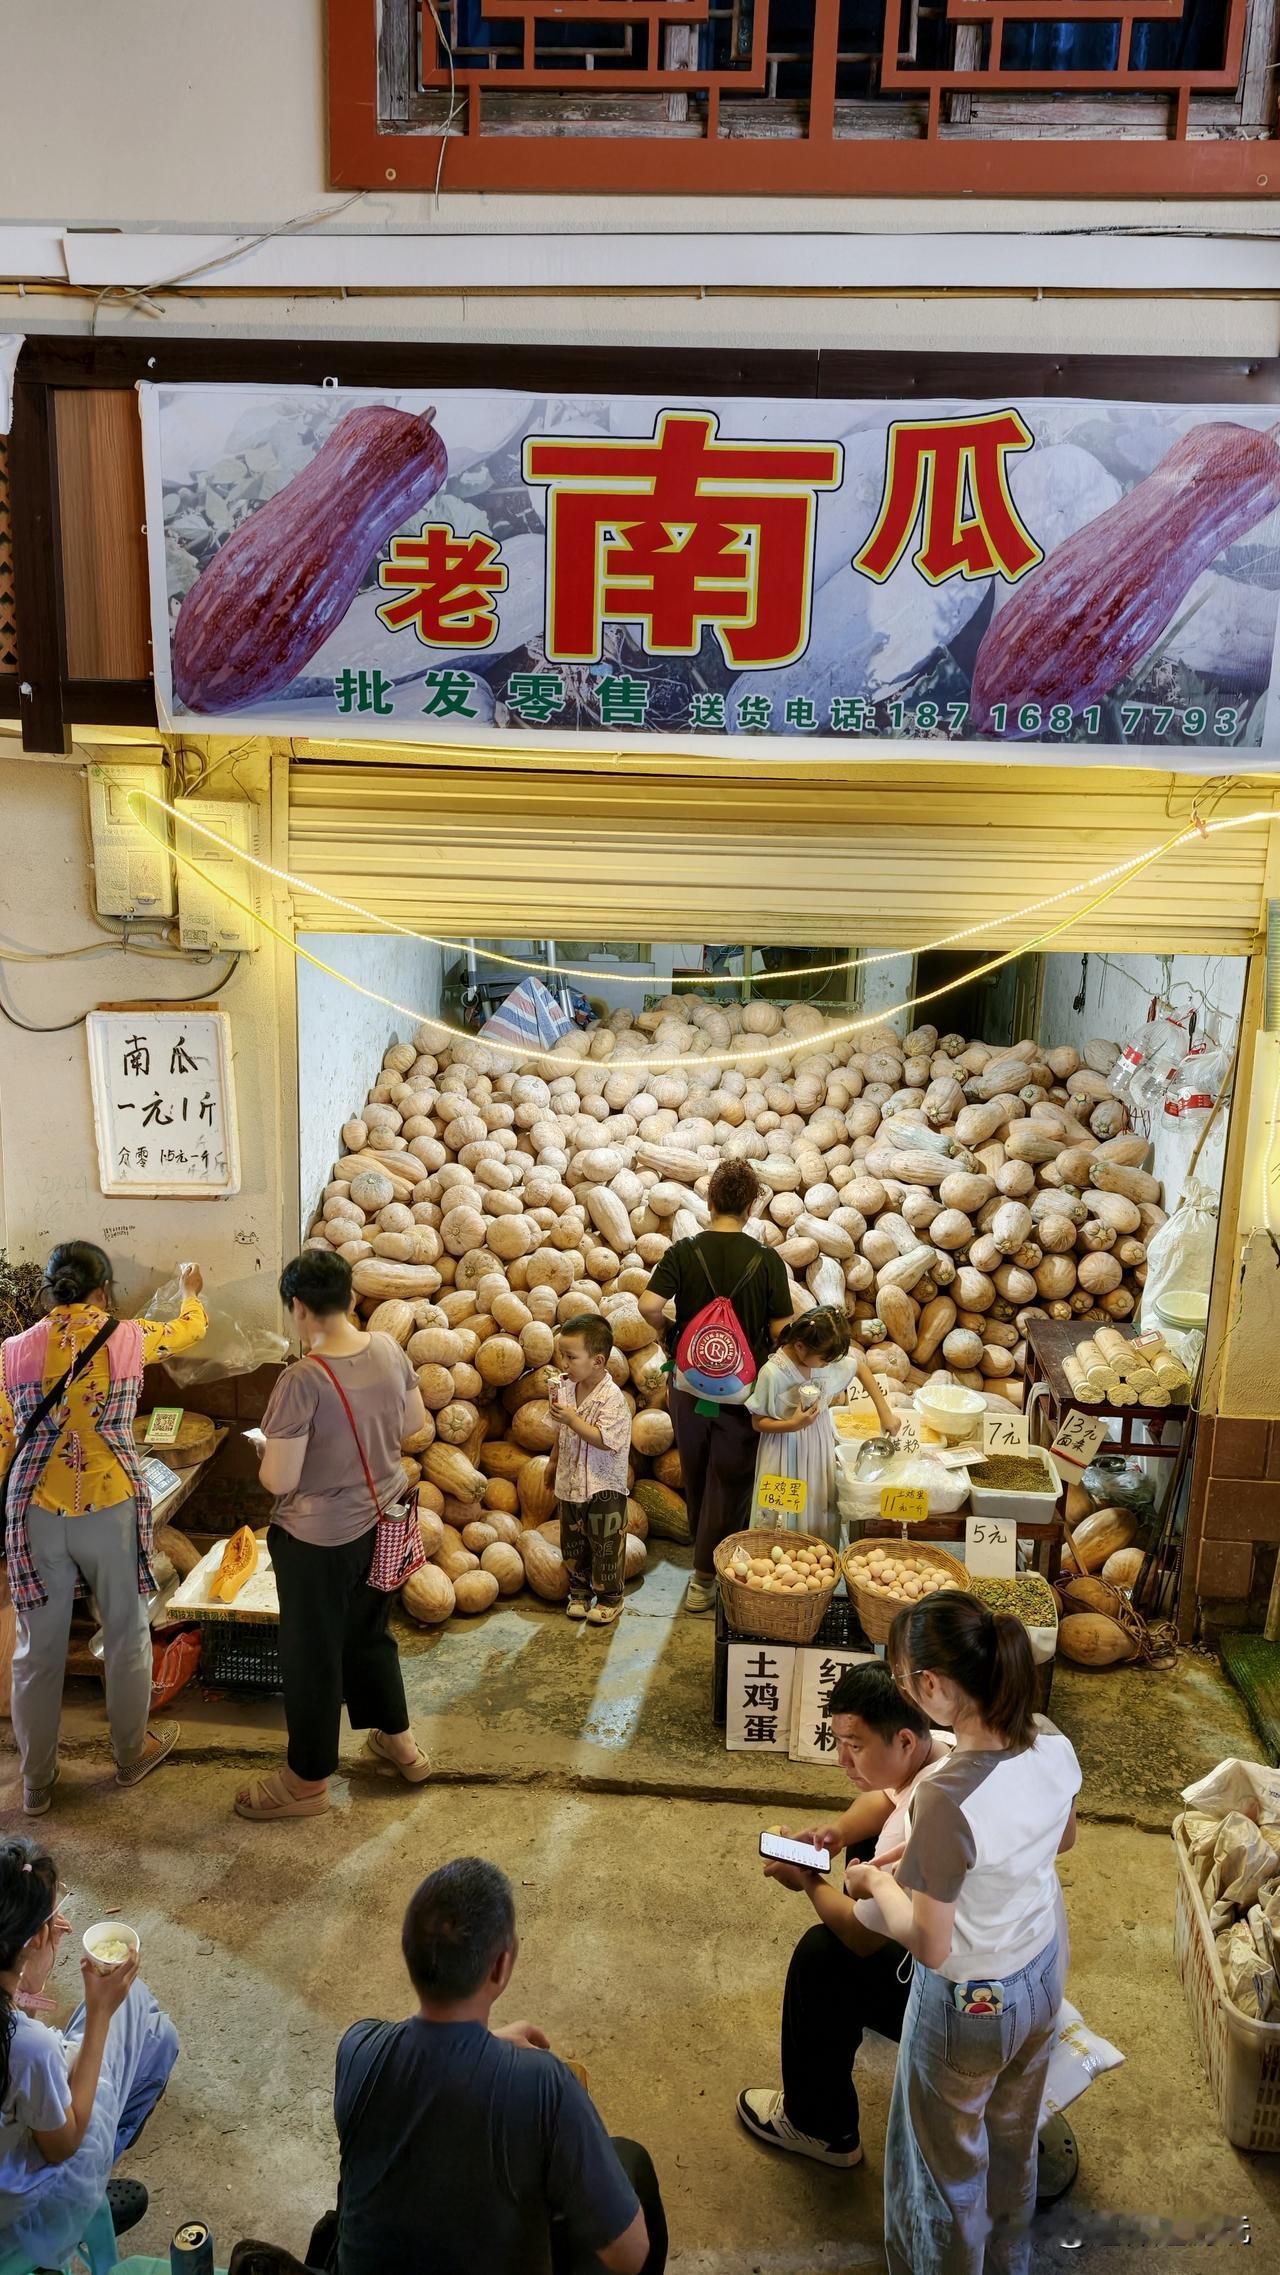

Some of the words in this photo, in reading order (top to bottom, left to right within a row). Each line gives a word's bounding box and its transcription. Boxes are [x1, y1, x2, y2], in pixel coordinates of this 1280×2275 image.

[379, 408, 1043, 670] 老南瓜
[334, 668, 650, 725] 批发零售
[990, 703, 1101, 734] 1681
[1122, 707, 1238, 736] 7793
[124, 1035, 198, 1076] 南瓜
[988, 1421, 1022, 1446] 7元
[1063, 1416, 1098, 1440] 13元
[760, 1481, 801, 1497] 土鸡蛋
[764, 1494, 801, 1511] 18元一斤
[973, 1524, 1008, 1544] 5元
[742, 1651, 780, 1744] 土鸡蛋
